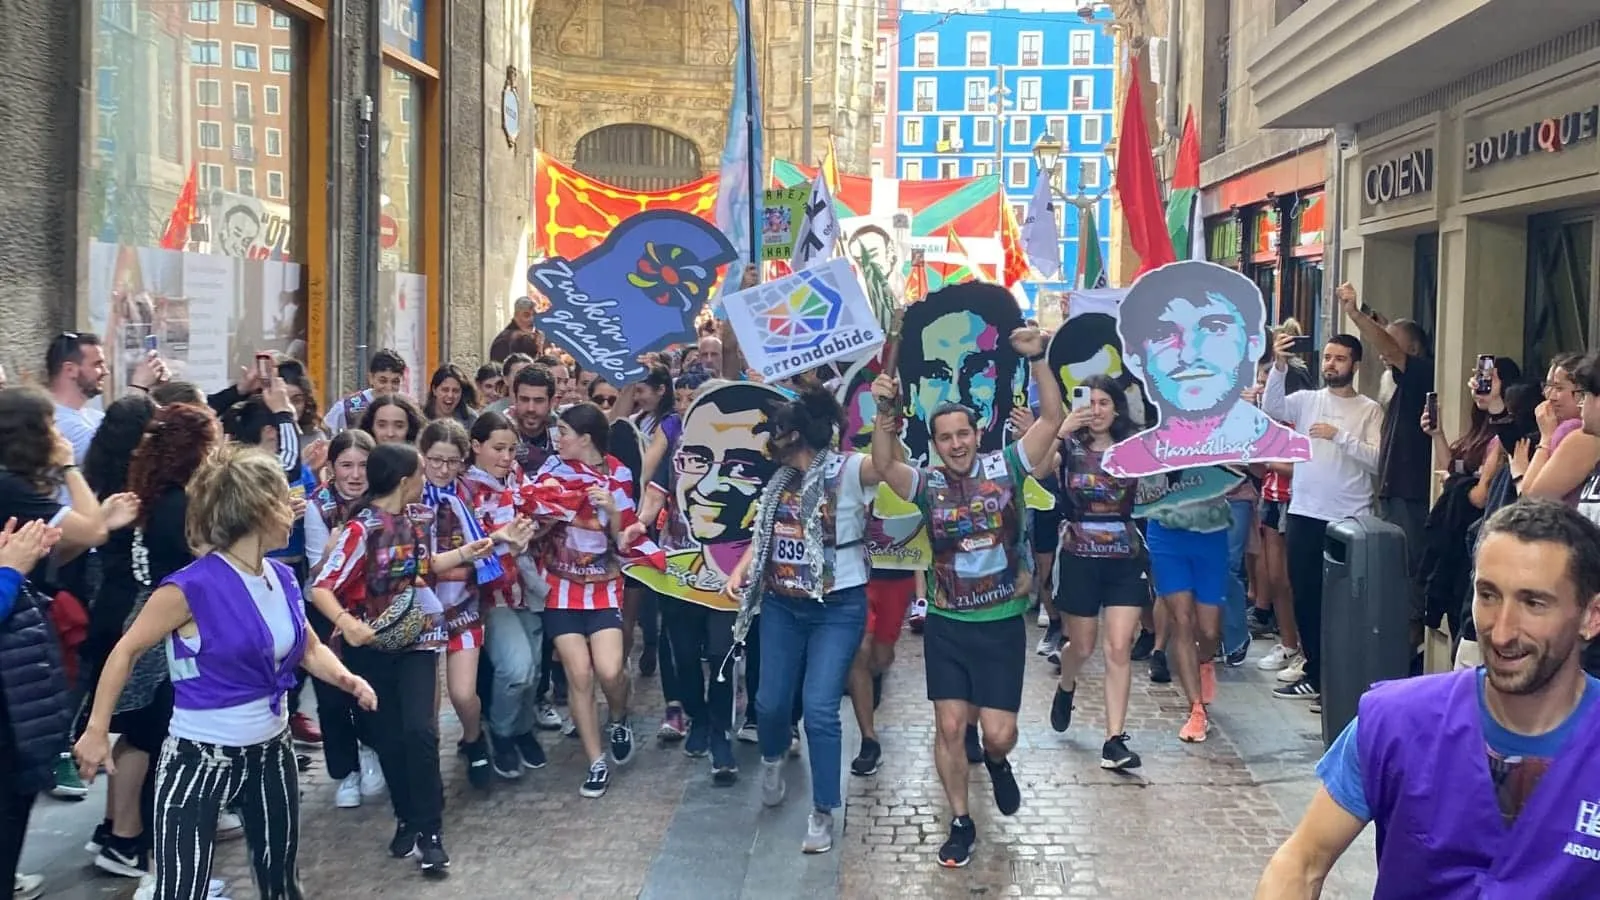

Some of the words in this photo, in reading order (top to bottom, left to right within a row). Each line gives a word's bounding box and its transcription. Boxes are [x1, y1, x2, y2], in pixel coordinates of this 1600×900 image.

[1466, 105, 1598, 169] BOUTIQUE
[762, 328, 874, 377] errondabide
[778, 540, 805, 561] 839
[955, 583, 1015, 608] 23.korrika
